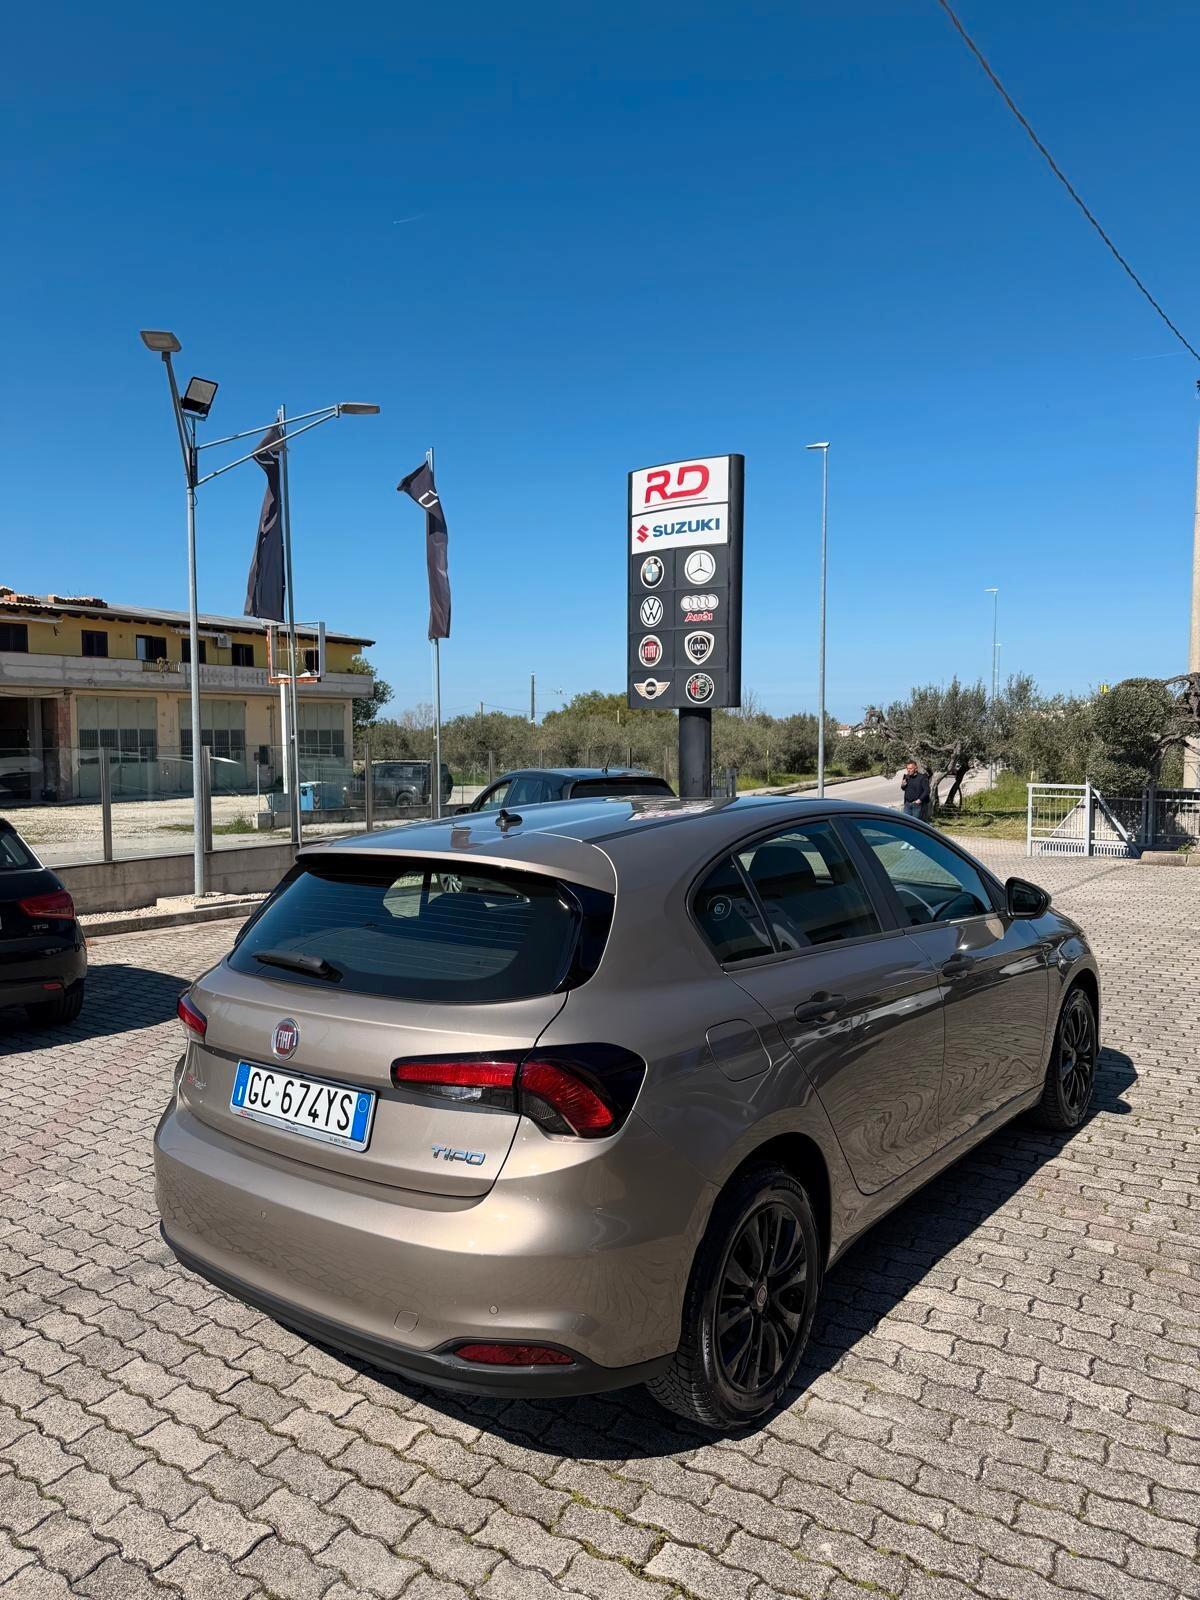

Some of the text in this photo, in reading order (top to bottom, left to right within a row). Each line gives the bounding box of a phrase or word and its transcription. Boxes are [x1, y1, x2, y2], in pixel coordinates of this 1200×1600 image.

[645, 465, 709, 504] RD
[653, 518, 720, 538] SUZUKI
[277, 1031, 293, 1049] FIAT
[431, 1143, 486, 1166] TIPO
